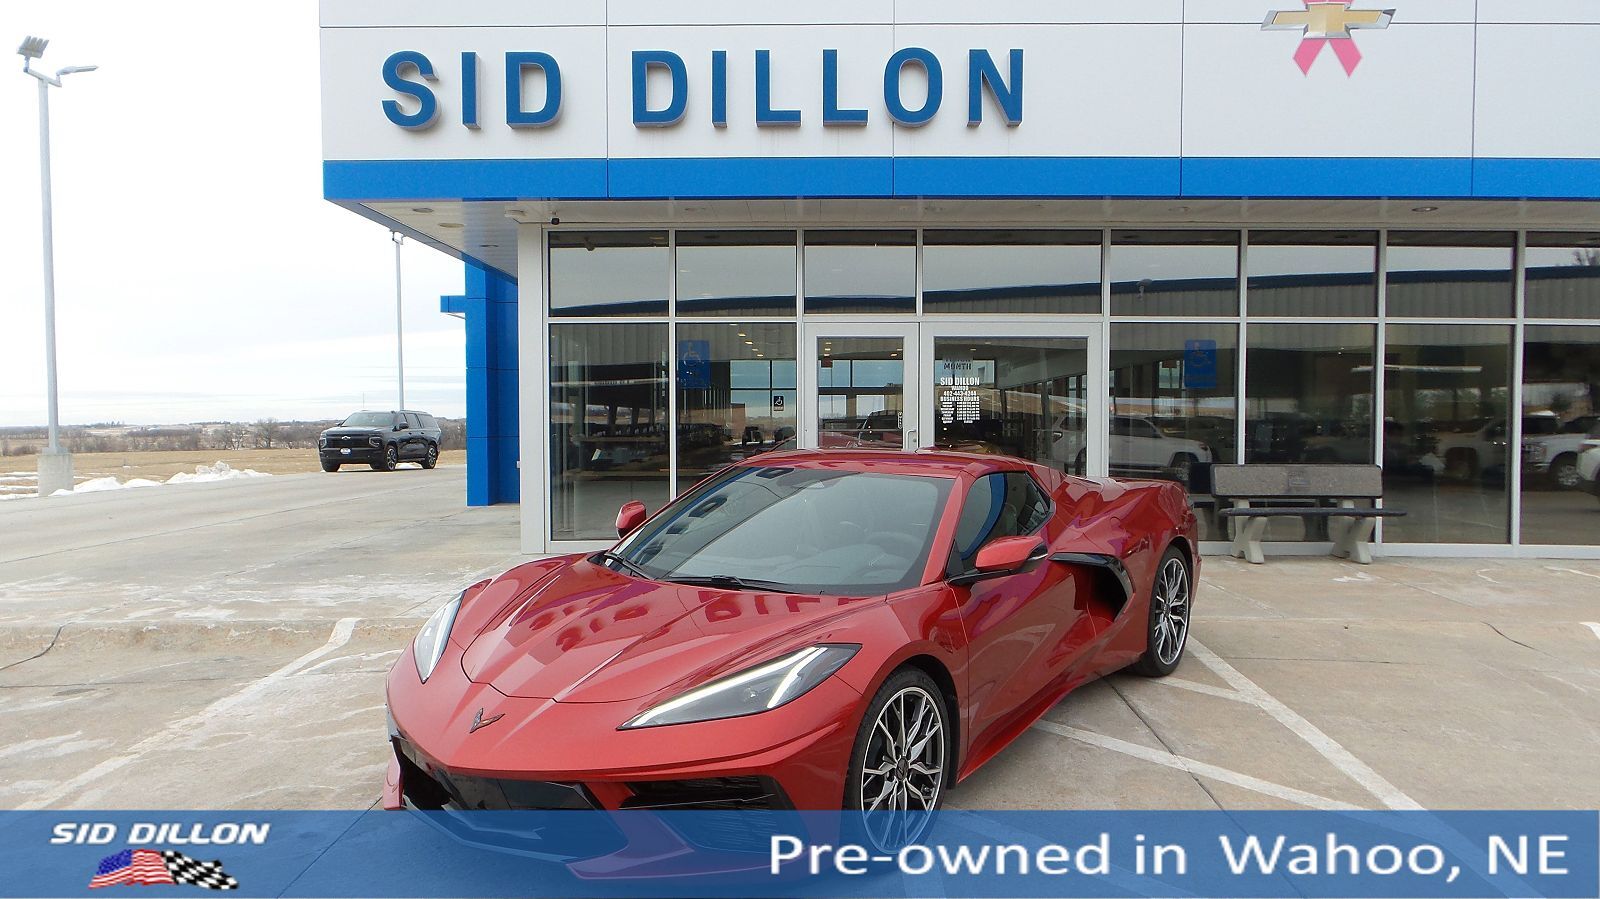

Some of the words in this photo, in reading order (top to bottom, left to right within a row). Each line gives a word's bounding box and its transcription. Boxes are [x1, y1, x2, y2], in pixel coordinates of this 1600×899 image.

[382, 50, 563, 130] SID
[631, 48, 1024, 128] DILLON
[940, 377, 953, 386] SID
[954, 377, 980, 386] DILLON
